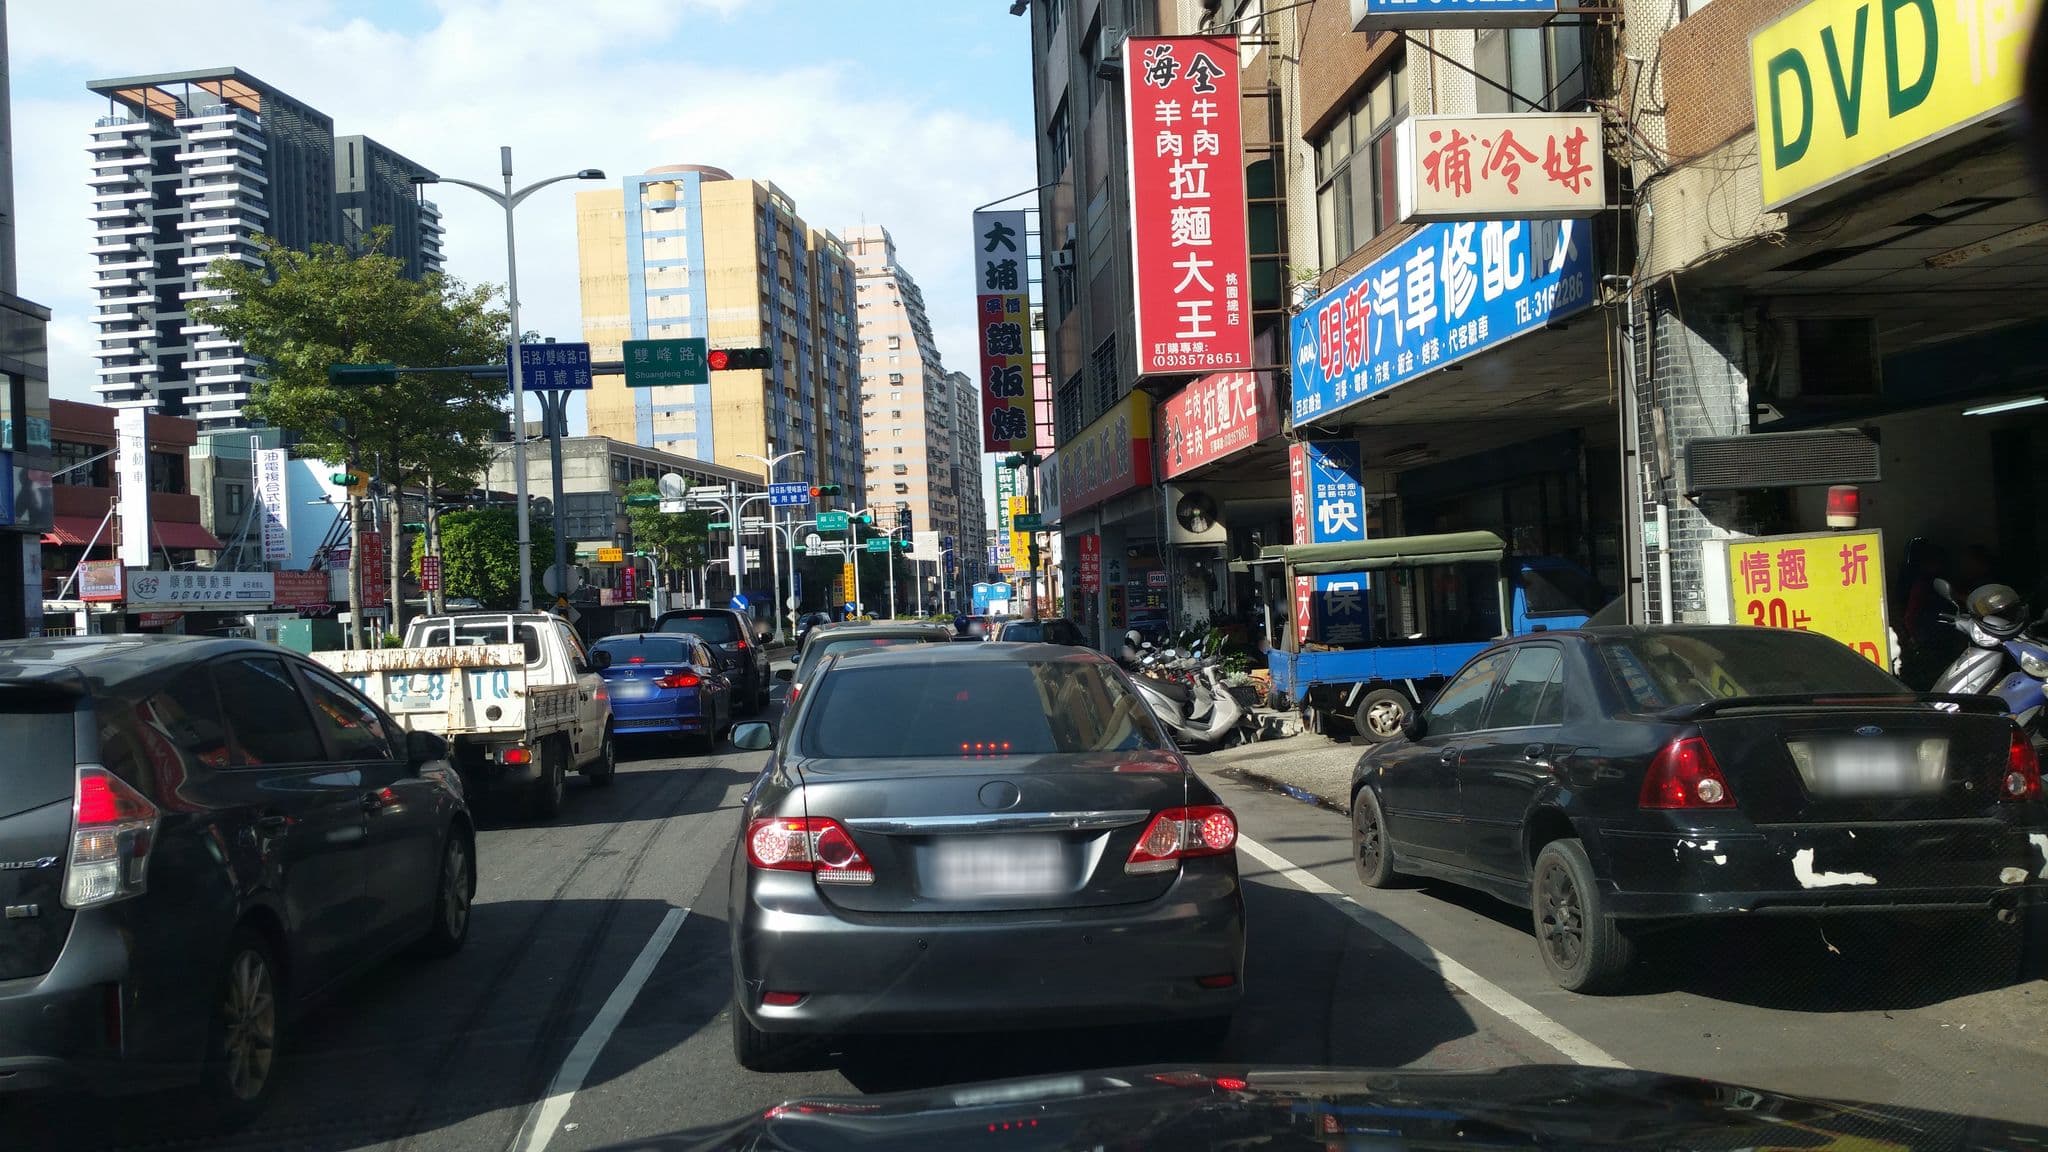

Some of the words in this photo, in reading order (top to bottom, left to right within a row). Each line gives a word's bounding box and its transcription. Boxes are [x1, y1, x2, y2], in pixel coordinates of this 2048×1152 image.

[1768, 0, 1939, 170] DVD
[1155, 98, 1183, 157] 羊肉
[1191, 98, 1220, 157] 牛肉
[1422, 126, 1594, 198] 補冷媒
[984, 221, 1018, 291] 大埔
[1168, 157, 1217, 339] 拉麵大王
[511, 350, 587, 366] 日路/雙峰路口
[521, 369, 589, 385] 用號誌
[634, 346, 695, 364] 雙峰路
[635, 371, 681, 379] Shuangfeng
[1152, 352, 1242, 367] (03)3578651
[987, 322, 1027, 441] 鐵板燒
[1185, 387, 1201, 425] 牛肉
[1187, 425, 1205, 459] 羊肉
[1739, 548, 1809, 595] 情趣
[1839, 543, 1870, 587] 折
